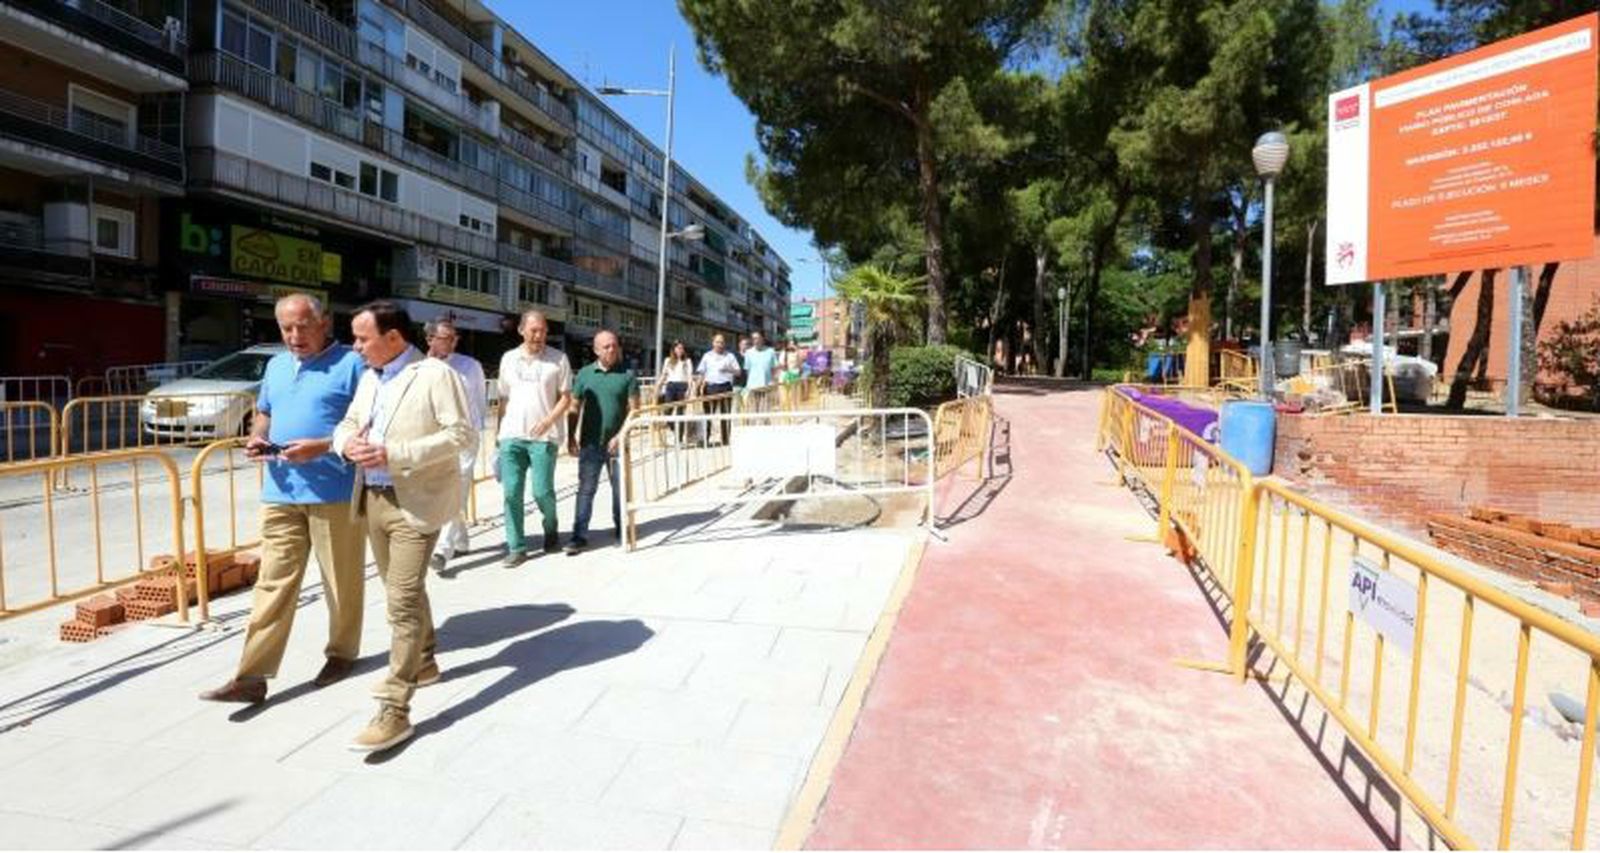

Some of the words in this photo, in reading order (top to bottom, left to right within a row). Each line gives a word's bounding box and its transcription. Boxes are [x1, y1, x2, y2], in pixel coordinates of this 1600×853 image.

[296, 246, 320, 263] EN
[235, 255, 289, 278] CADA
[1351, 571, 1377, 601] API
